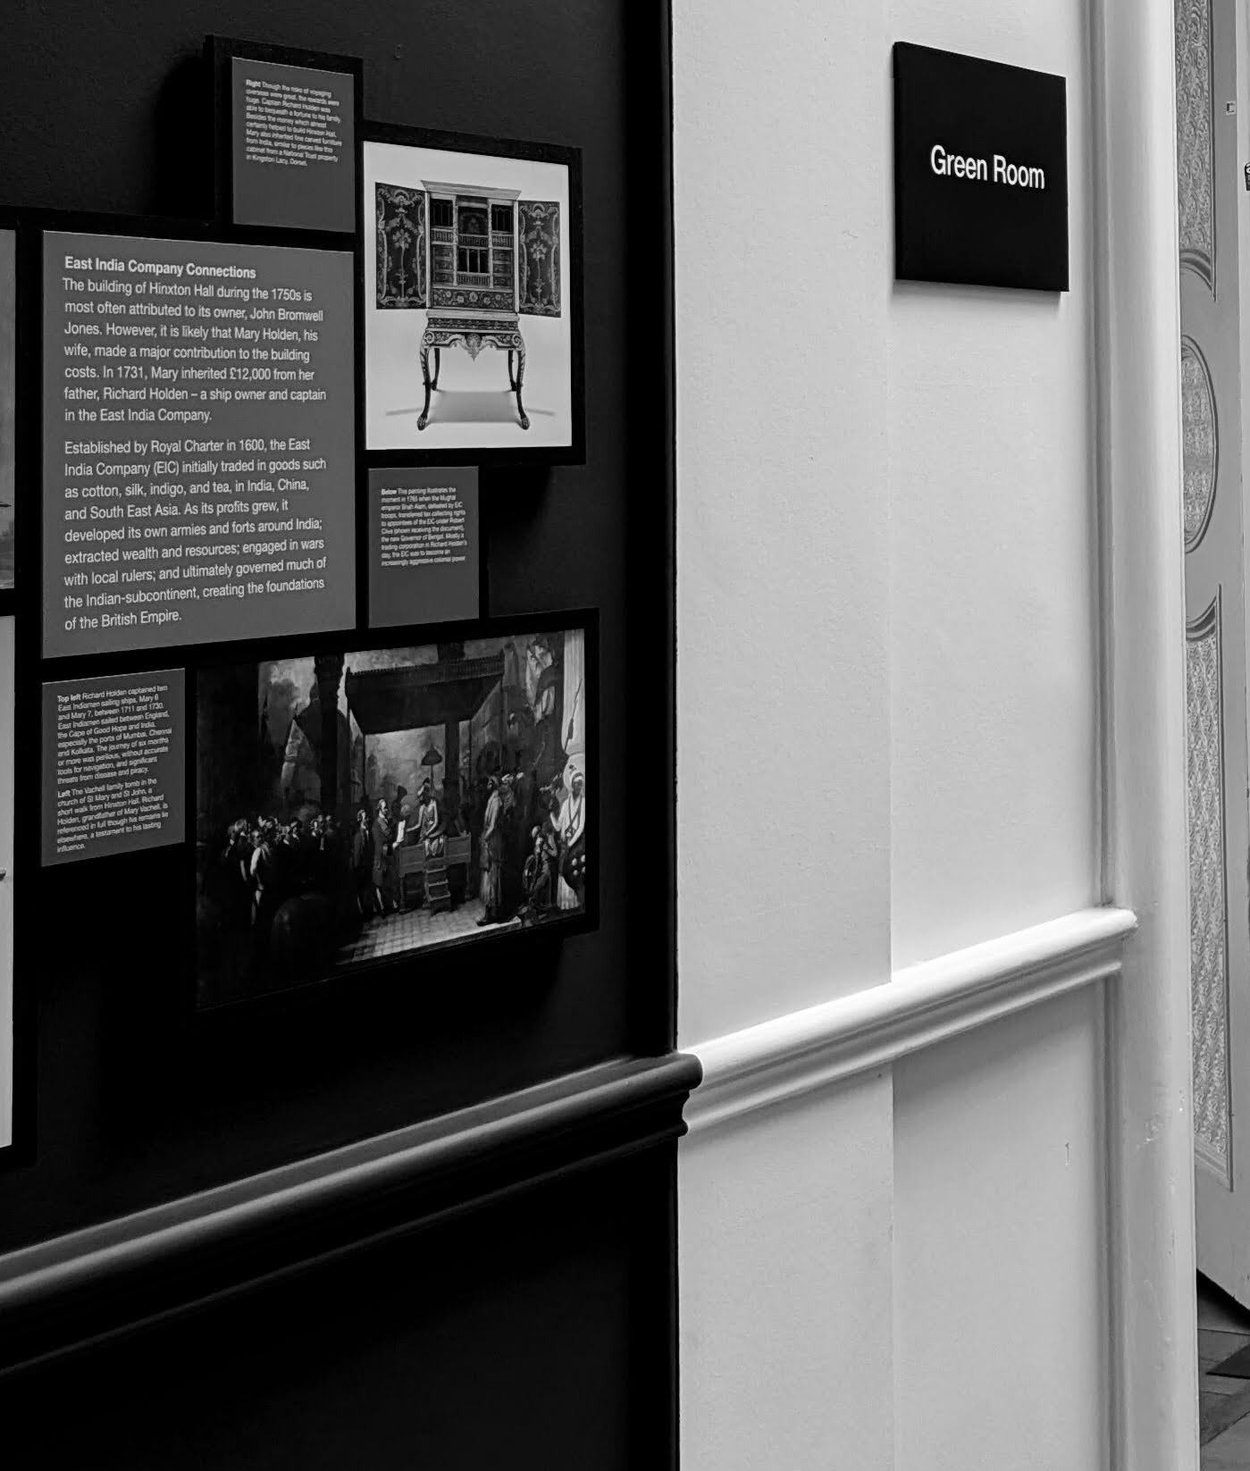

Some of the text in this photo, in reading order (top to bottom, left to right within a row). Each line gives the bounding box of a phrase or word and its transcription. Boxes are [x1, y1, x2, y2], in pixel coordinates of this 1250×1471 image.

[930, 144, 1045, 190] Green Room
[64, 255, 256, 278] East India Company Connections
[62, 277, 312, 301] The building of Hinxton Hall during the 1750s is
[64, 301, 323, 321] most often attributed to its owner, John Bromwell
[64, 321, 318, 341] Jones. However, it is likely that Mary Holden, his
[64, 343, 309, 363] wife, made a major contribution to the building
[64, 365, 314, 381] costs. In 1731, Mary inherited £12,000 from her
[64, 386, 326, 402] father, Richard Holden a ship owner and captain
[65, 408, 211, 423] in the East India Company.
[65, 438, 310, 455] Established by Royal Charter in 1600, the East
[65, 458, 326, 477] India Company (EIC) initially traded in goods such
[64, 478, 309, 497] as cotton, silk, indigo, and tea, in India, China,
[64, 498, 288, 520] and South East Asia. As its profits grew, it
[64, 517, 321, 542] developed its own armies and forts around India;
[64, 539, 324, 563] extracted wealth and resources; engaged in wars
[63, 556, 326, 585] with local rulers; and ultimately governed much of
[64, 595, 82, 608] the
[202, 583, 244, 597] creating
[247, 581, 264, 593] the
[265, 578, 324, 592] foundations
[64, 609, 181, 630] of the British Empire.
[57, 695, 69, 703] Top
